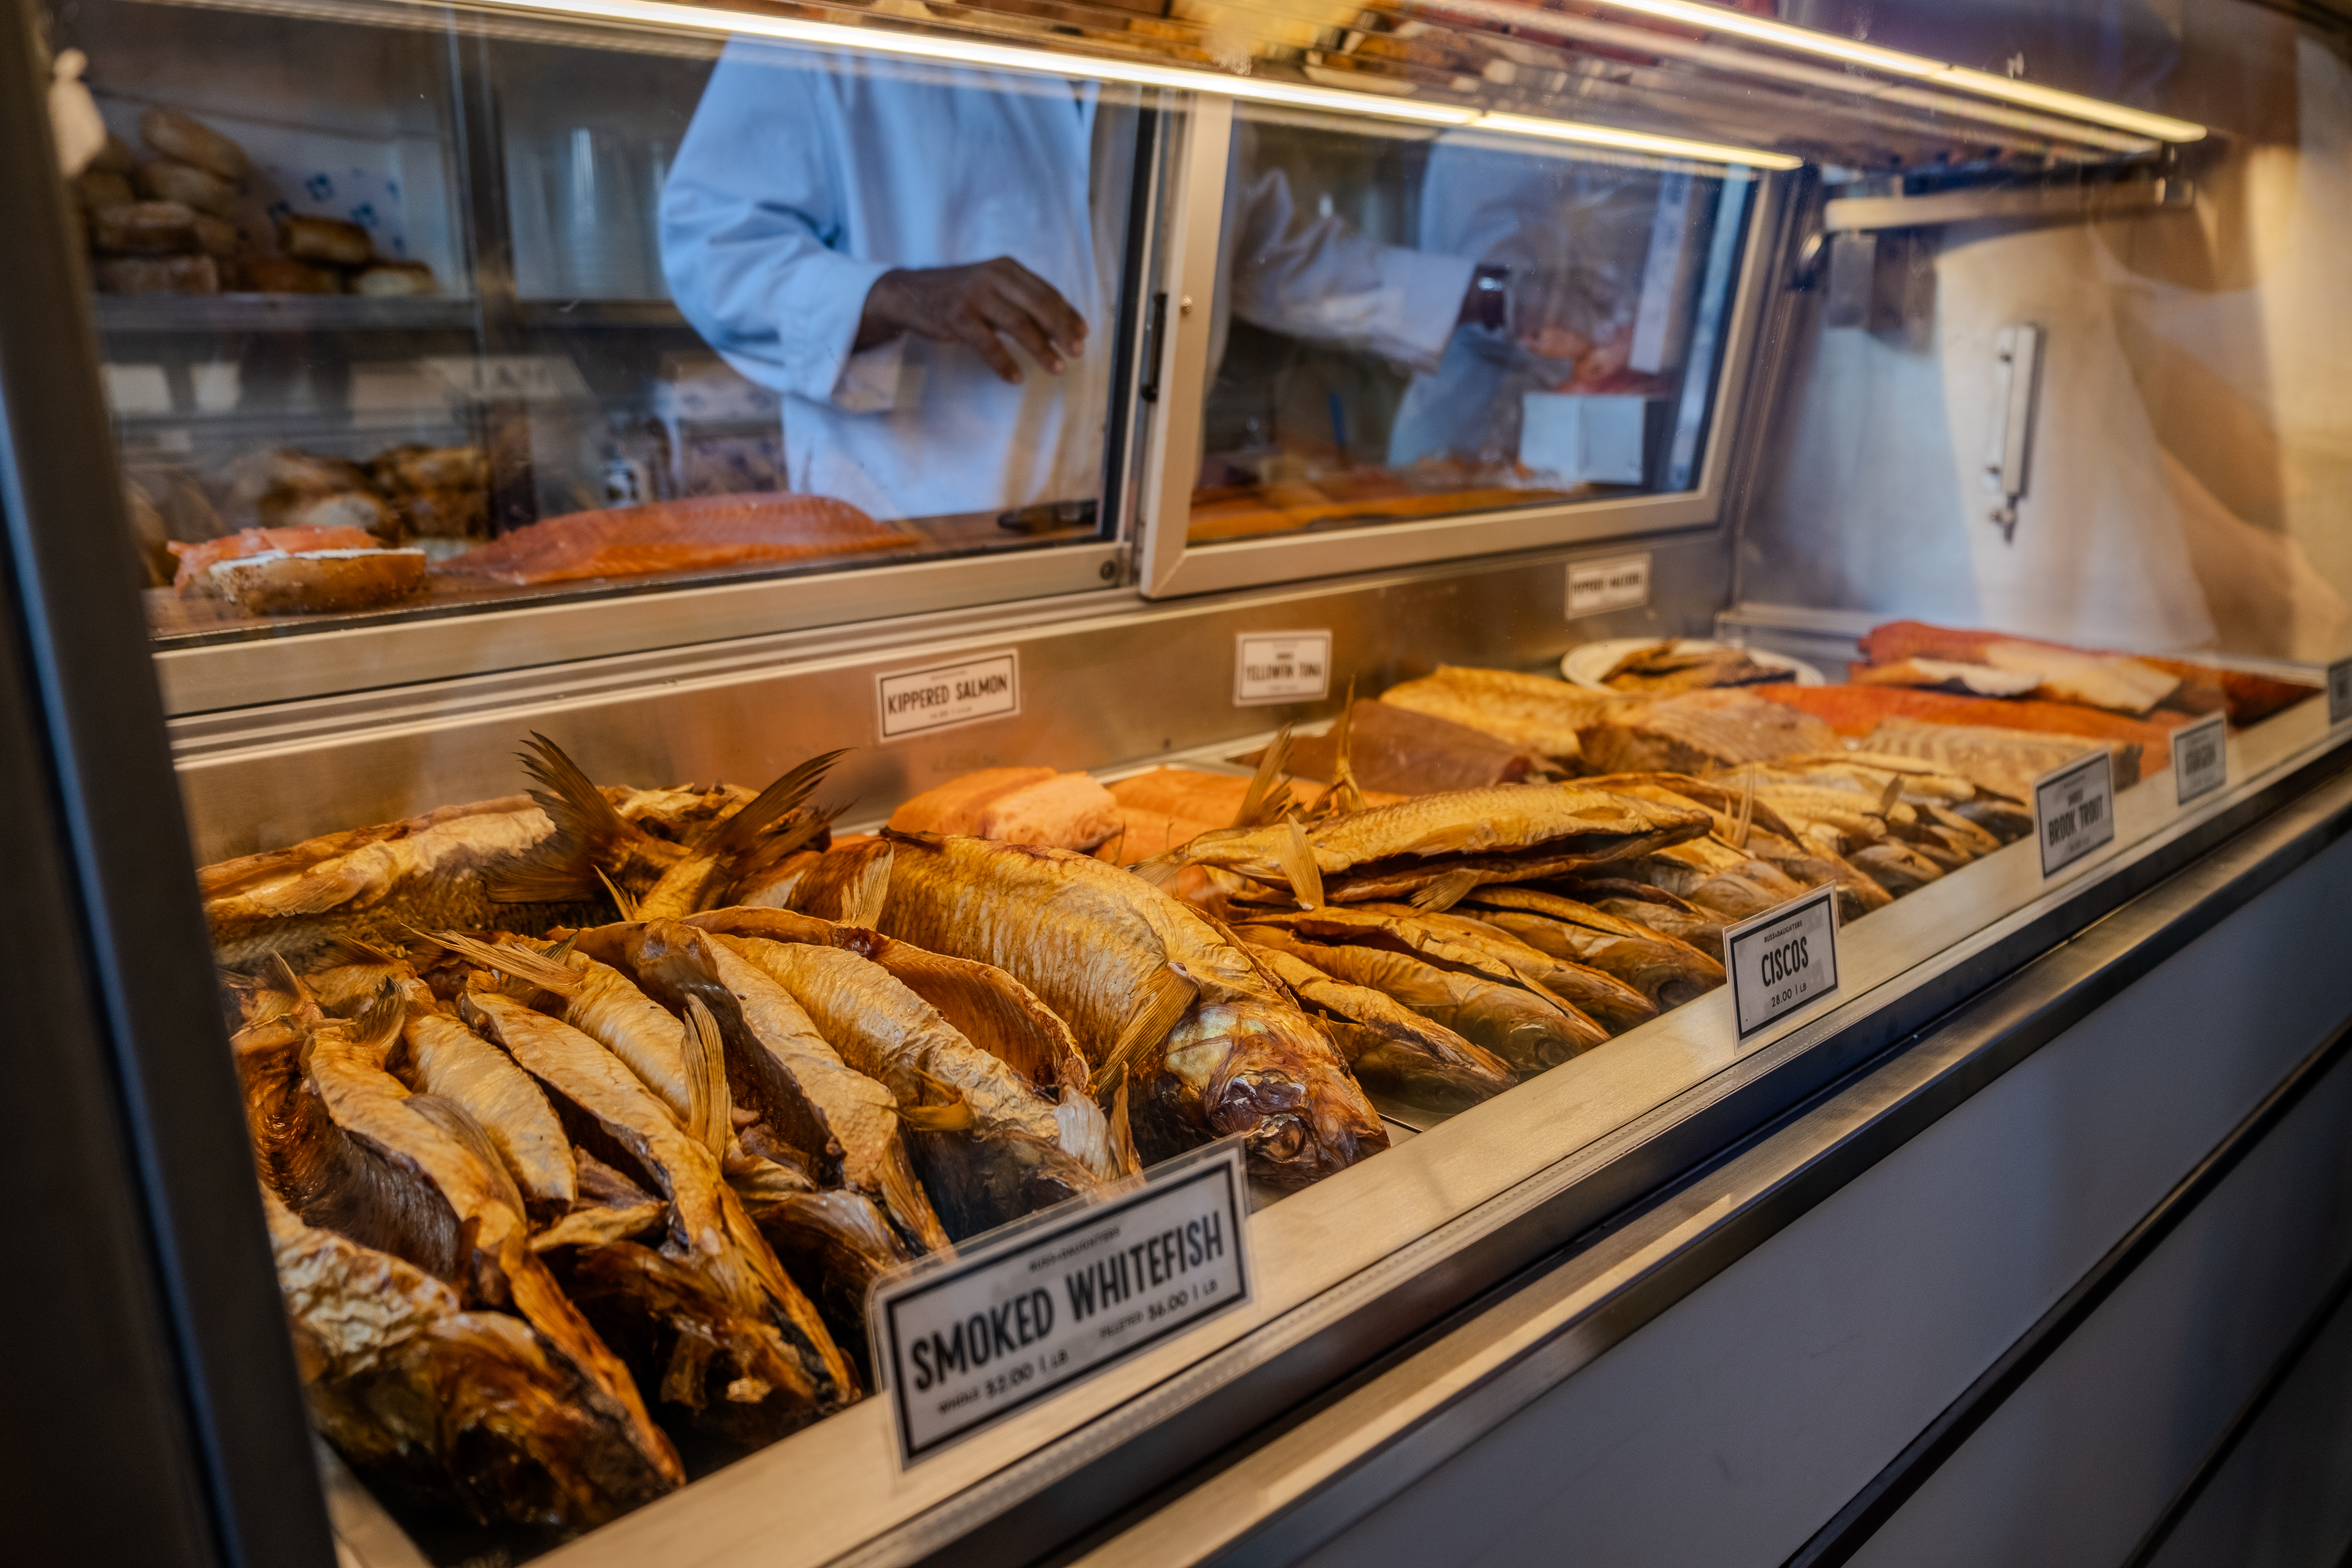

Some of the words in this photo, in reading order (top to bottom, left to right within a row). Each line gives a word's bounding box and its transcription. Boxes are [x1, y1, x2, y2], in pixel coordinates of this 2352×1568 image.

[888, 685, 949, 715] KIPPERED
[956, 673, 1008, 701] SALMON
[2048, 810, 2077, 847] BROOK
[2079, 794, 2103, 827] TROUT
[1761, 936, 1809, 987] CISCOS
[1772, 988, 1792, 1008] 28.00
[1800, 982, 1807, 993] LB
[911, 1287, 1054, 1390] SMOKED
[1065, 1210, 1224, 1322] WHITEFISH
[1203, 1279, 1218, 1295] LB
[1050, 1349, 1068, 1368] LB
